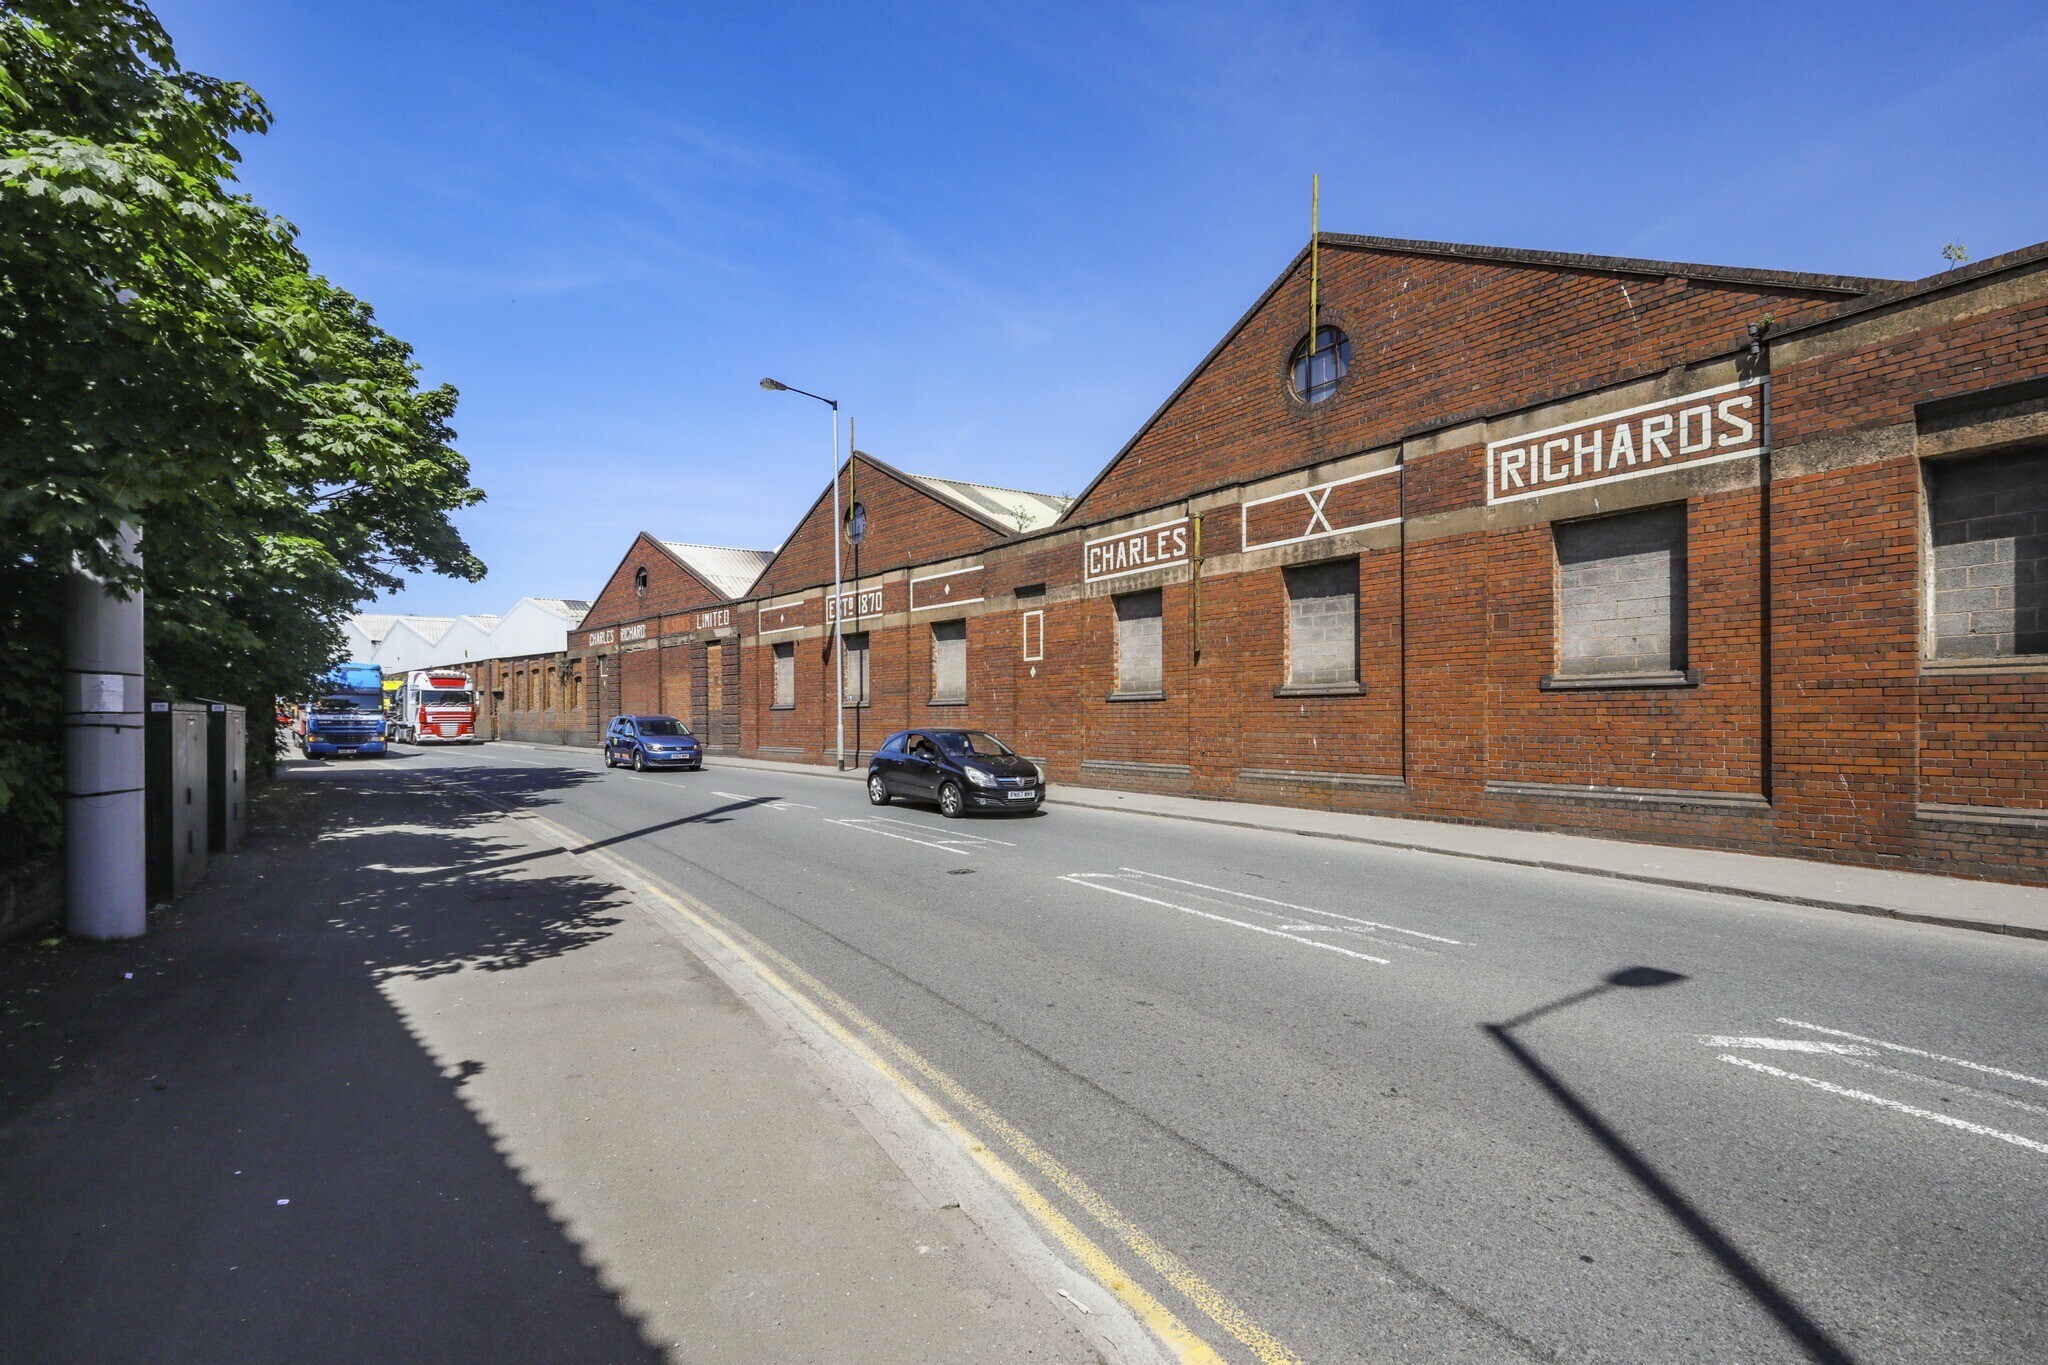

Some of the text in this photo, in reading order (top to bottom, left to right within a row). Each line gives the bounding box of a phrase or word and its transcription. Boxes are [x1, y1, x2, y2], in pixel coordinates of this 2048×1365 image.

[1500, 395, 1753, 490] RICHARDS
[1089, 527, 1187, 574] CHARLES
[858, 592, 883, 614] 1870
[589, 630, 615, 646] CHARLES
[696, 610, 730, 629] LIMITED
